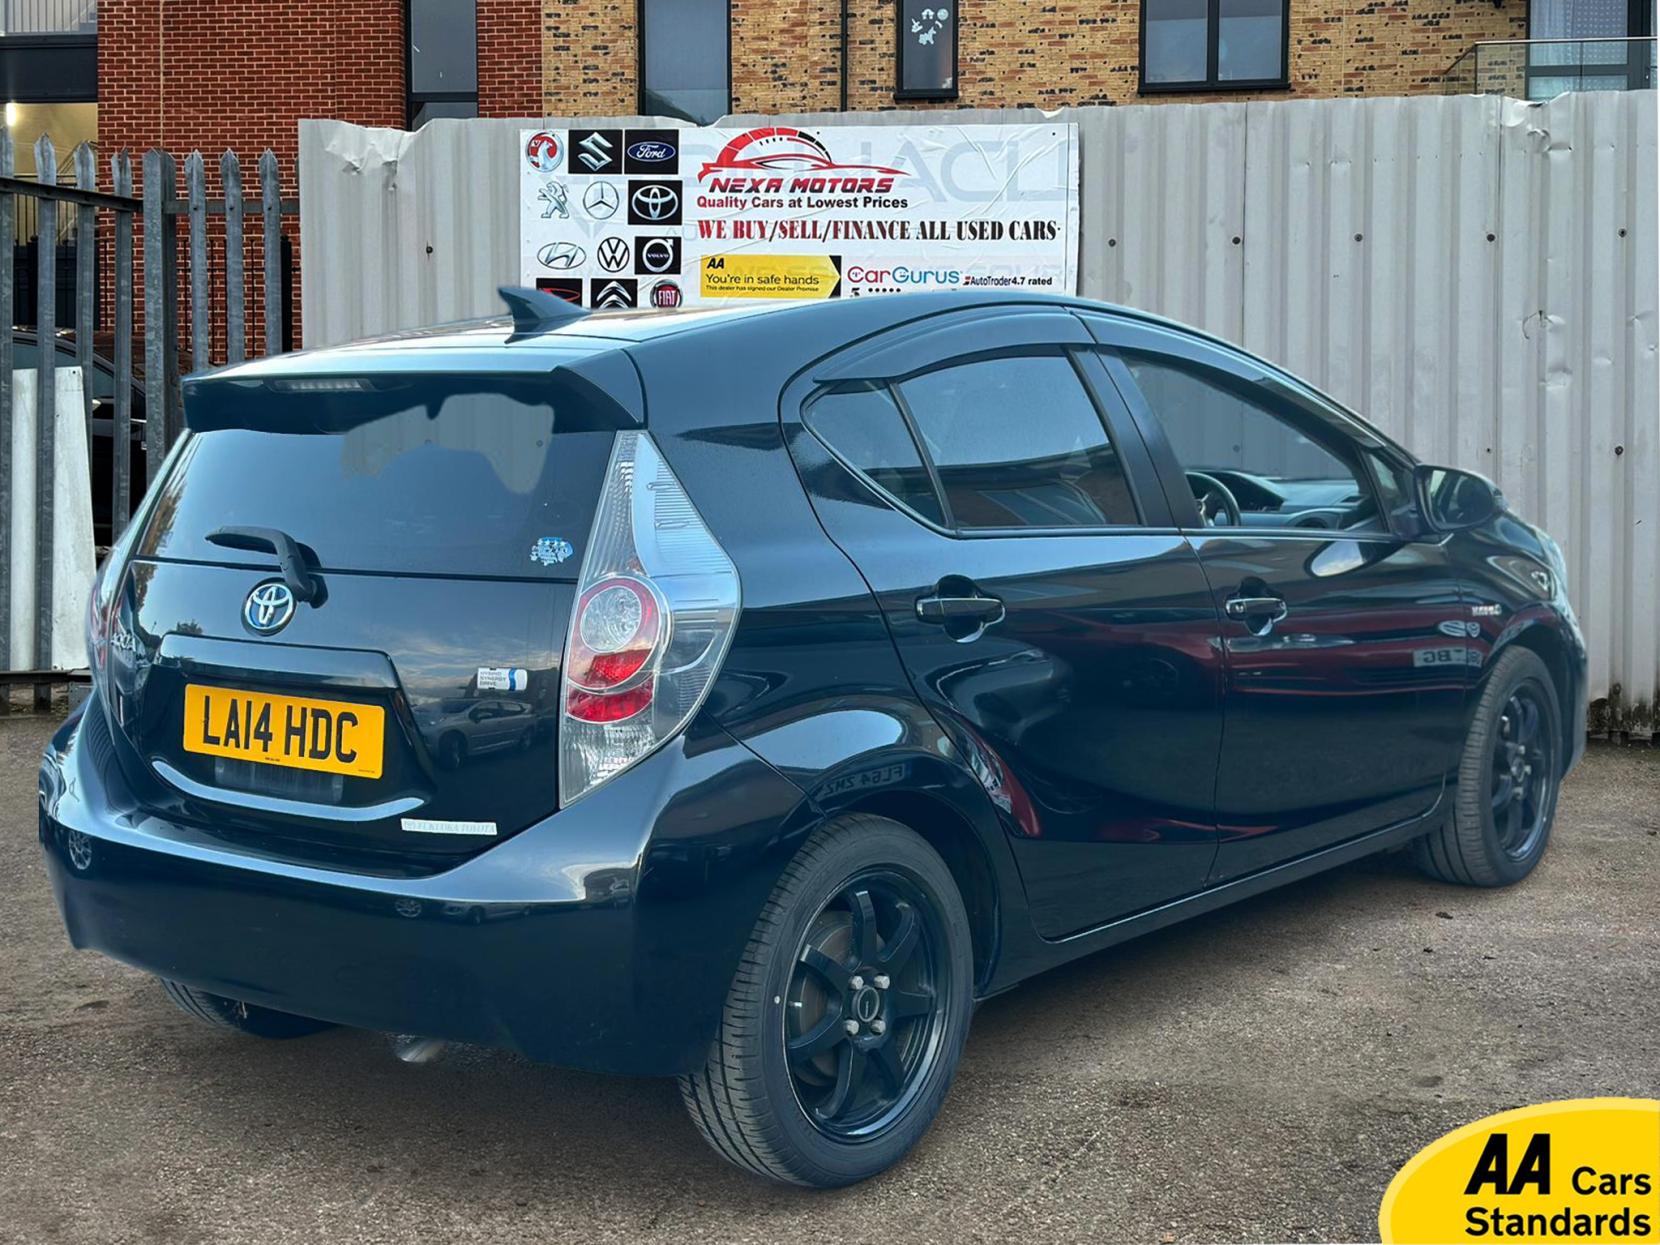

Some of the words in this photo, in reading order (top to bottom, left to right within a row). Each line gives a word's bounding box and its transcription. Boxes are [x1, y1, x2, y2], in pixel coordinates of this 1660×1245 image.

[636, 144, 666, 158] Ford
[709, 178, 783, 193] NEXA
[789, 178, 894, 193] MOTORS
[697, 196, 747, 210] Quality
[752, 197, 784, 208] Cars
[788, 197, 803, 208] at
[807, 196, 858, 208] Lowest
[863, 196, 908, 208] Prices
[697, 220, 727, 239] WE
[916, 221, 950, 240] ALL
[957, 221, 1004, 240] USED
[707, 258, 725, 269] AA
[706, 274, 741, 284] You're
[744, 274, 754, 284] in
[757, 274, 781, 285] safe
[784, 275, 820, 285] hands
[847, 266, 960, 284] CarGurus
[1028, 277, 1052, 286] rated
[658, 290, 677, 305] FIAT
[203, 695, 273, 753] LA14
[284, 705, 359, 764] HDC
